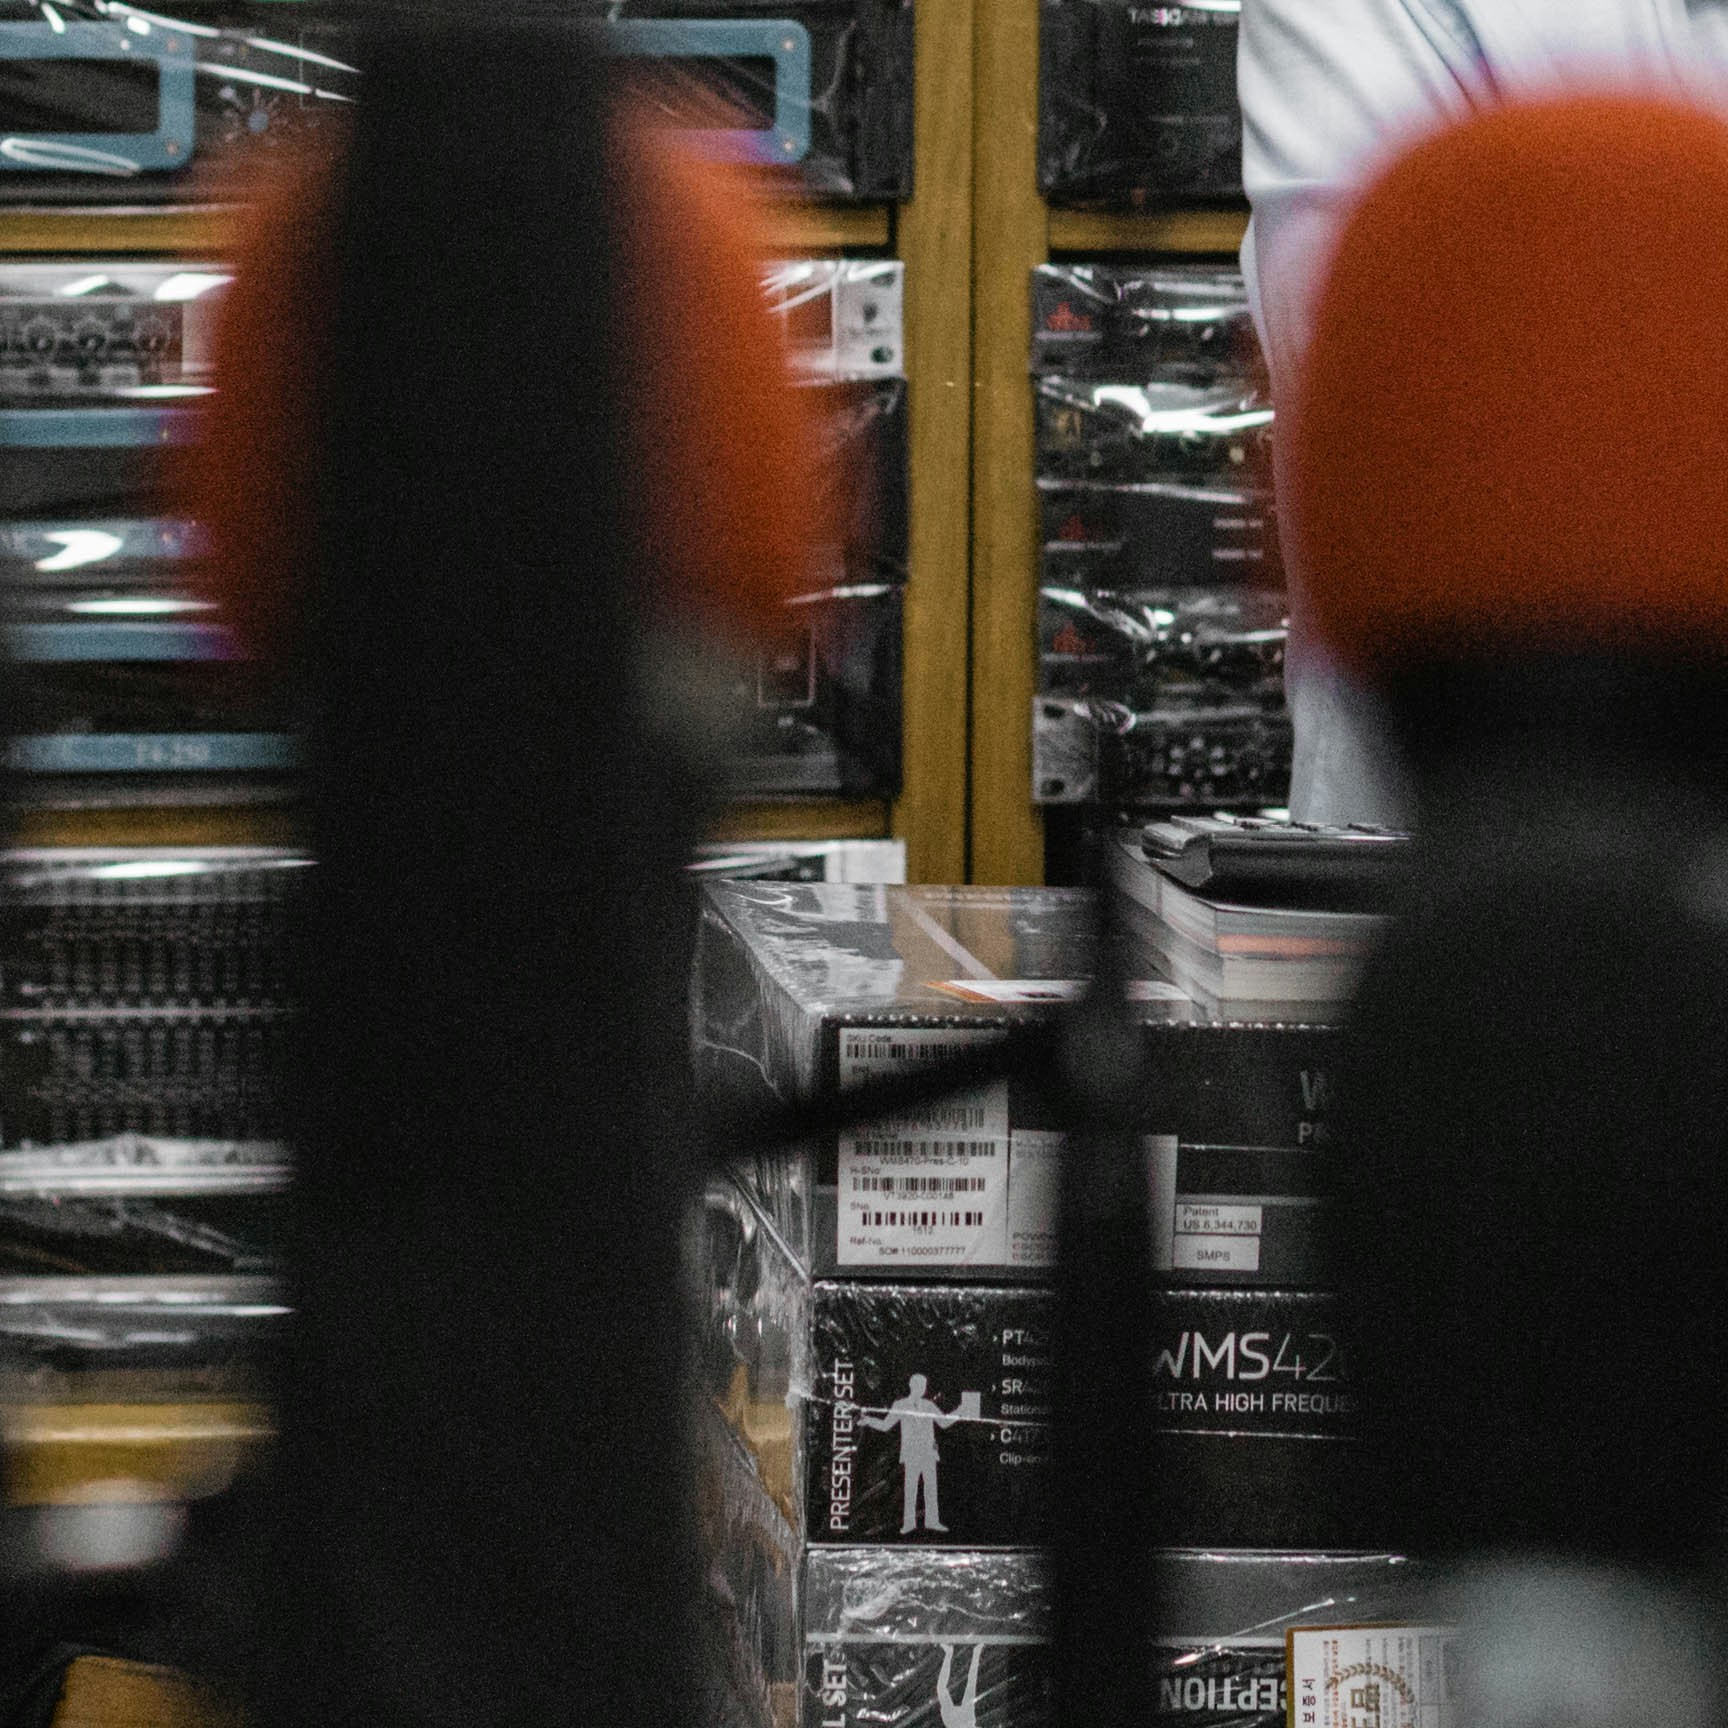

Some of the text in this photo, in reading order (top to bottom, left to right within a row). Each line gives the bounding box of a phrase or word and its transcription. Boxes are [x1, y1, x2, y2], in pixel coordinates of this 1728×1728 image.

[1183, 1206, 1220, 1217] Patent
[1183, 1220, 1201, 1231] US
[1196, 1249, 1231, 1262] SMPS
[1153, 1332, 1340, 1381] WMS42
[1215, 1394, 1264, 1412] HIGH
[829, 1358, 856, 1531] PRESENTER SET
[1158, 1676, 1287, 1712] EPTION
